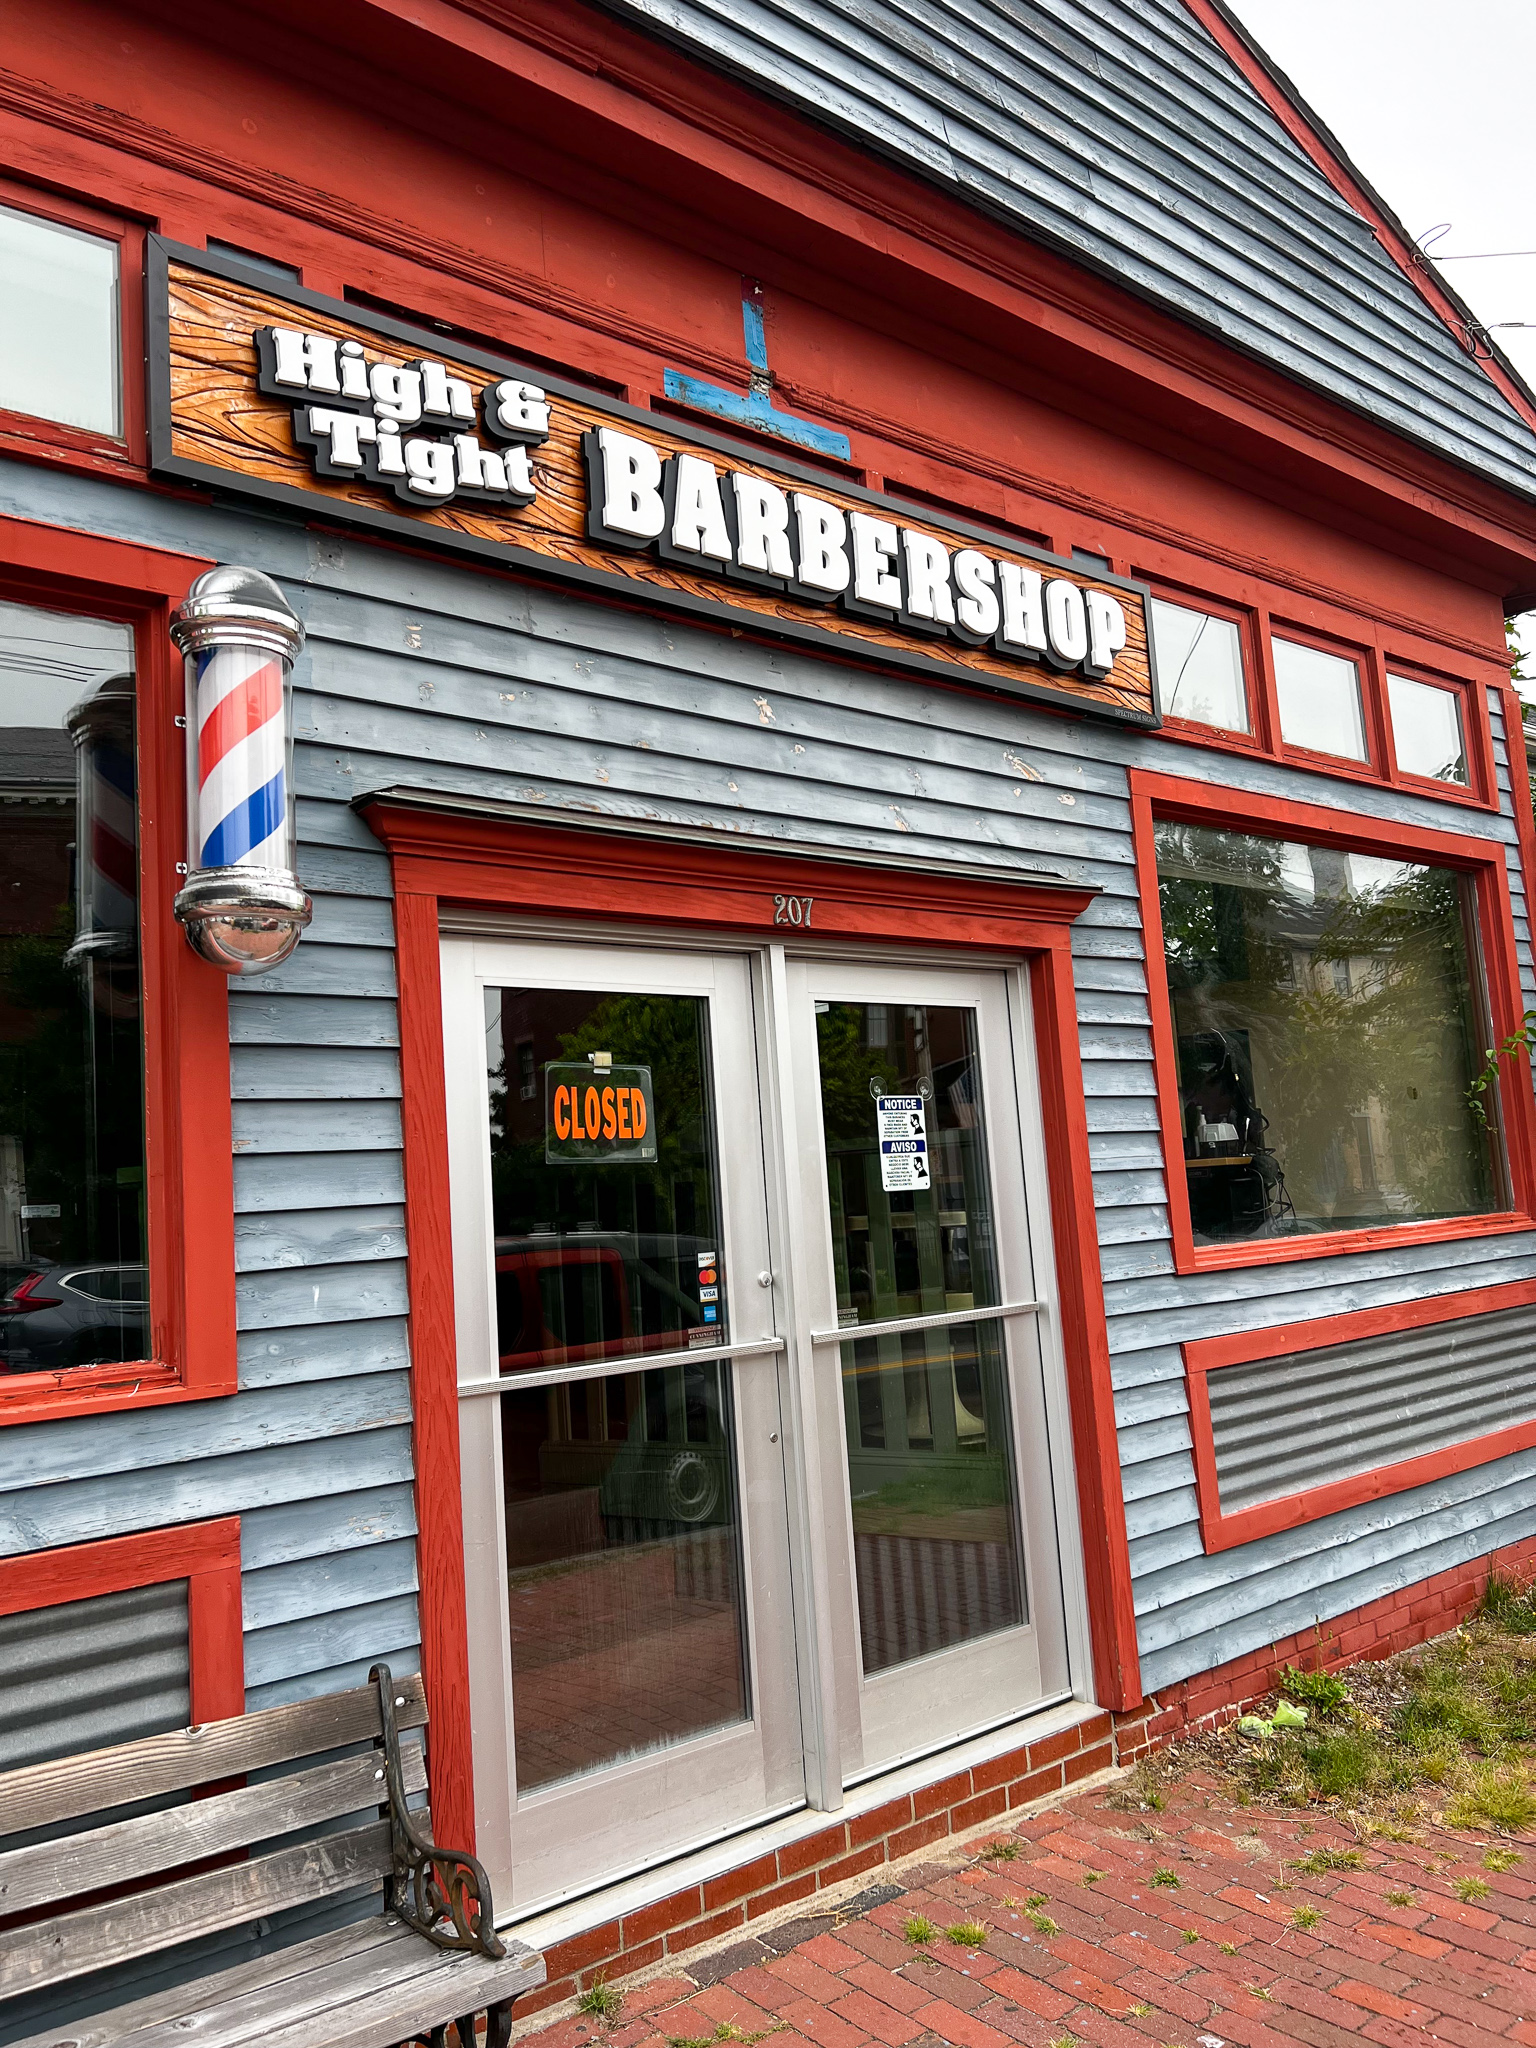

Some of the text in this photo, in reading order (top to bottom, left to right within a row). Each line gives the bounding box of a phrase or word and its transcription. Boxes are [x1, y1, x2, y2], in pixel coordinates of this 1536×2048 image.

[272, 326, 551, 437] High &
[308, 406, 536, 497] Tight
[600, 427, 1127, 670] BARBERSHOP
[1114, 708, 1157, 724] SPECTRUM SIGNS
[773, 894, 813, 927] 207
[554, 1084, 647, 1140] CLOSED
[884, 1099, 917, 1110] NOTICE
[890, 1141, 917, 1153] AVISO
[702, 1290, 716, 1298] VISA
